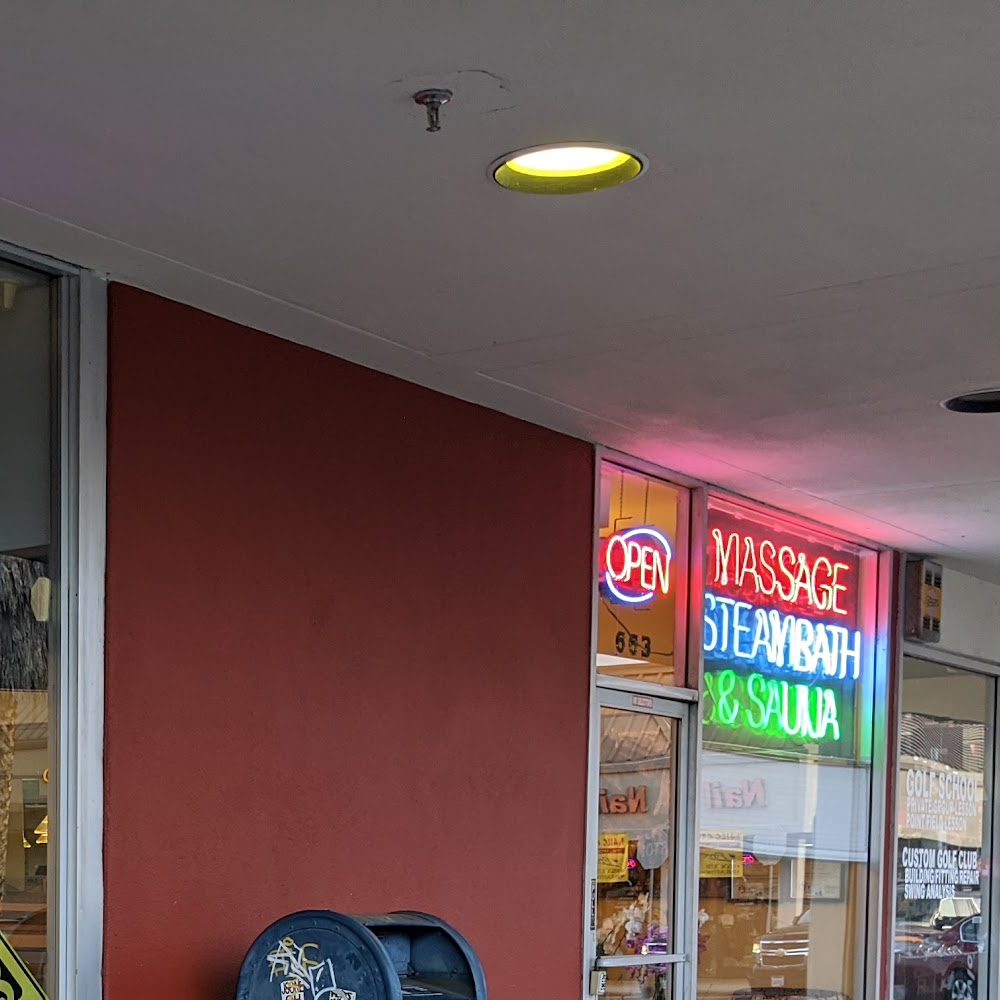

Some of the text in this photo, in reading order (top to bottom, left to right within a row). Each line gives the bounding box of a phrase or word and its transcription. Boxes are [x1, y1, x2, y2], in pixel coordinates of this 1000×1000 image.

[605, 535, 670, 594] OPEN
[712, 528, 849, 615] MASSAGE
[907, 769, 978, 802] GOLF SCHOOL
[902, 846, 978, 870] CUSTOM GOLF CLUB
[904, 868, 934, 884] BUILDING
[959, 870, 980, 885] REPAIR
[904, 884, 955, 899] SWING ANALYSIS
